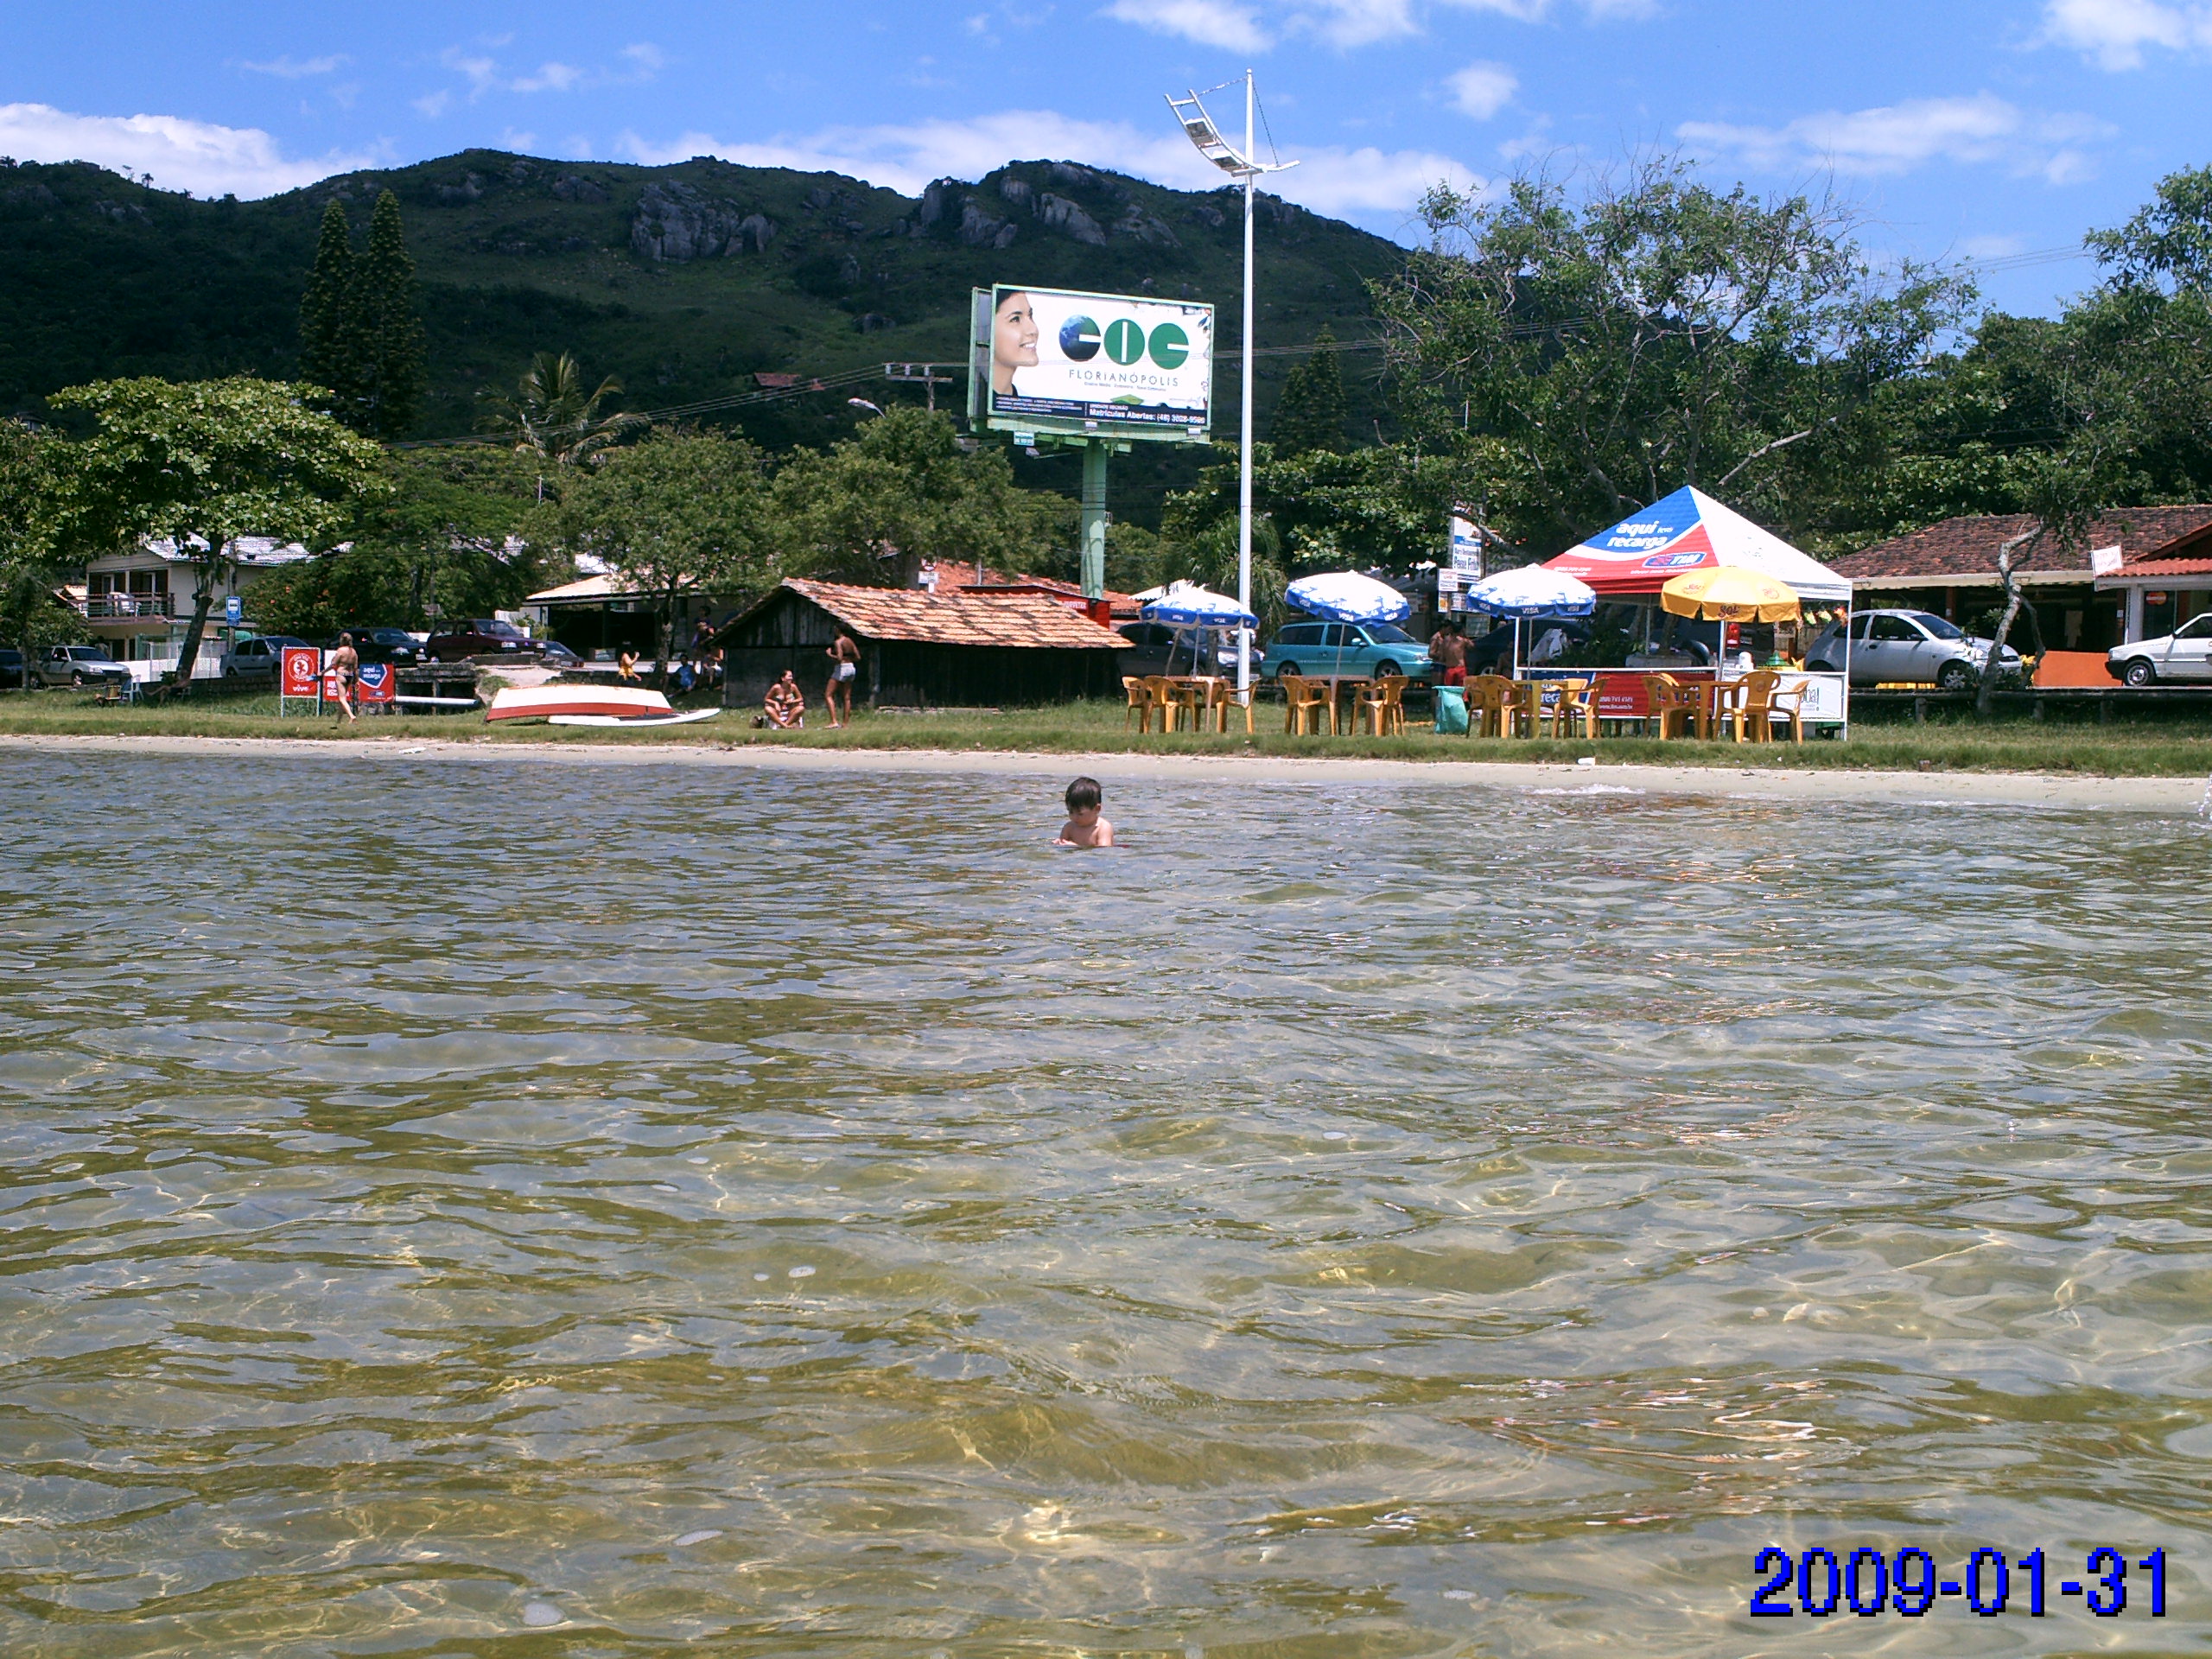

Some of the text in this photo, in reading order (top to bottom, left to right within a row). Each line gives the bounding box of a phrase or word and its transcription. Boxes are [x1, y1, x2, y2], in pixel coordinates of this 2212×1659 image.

[1069, 369, 1179, 386] FLORIANÓPOLIS
[1616, 520, 1660, 537] aqui
[1607, 537, 1668, 550] recarga
[1669, 554, 1700, 564] TIM
[1541, 693, 1561, 703] reca
